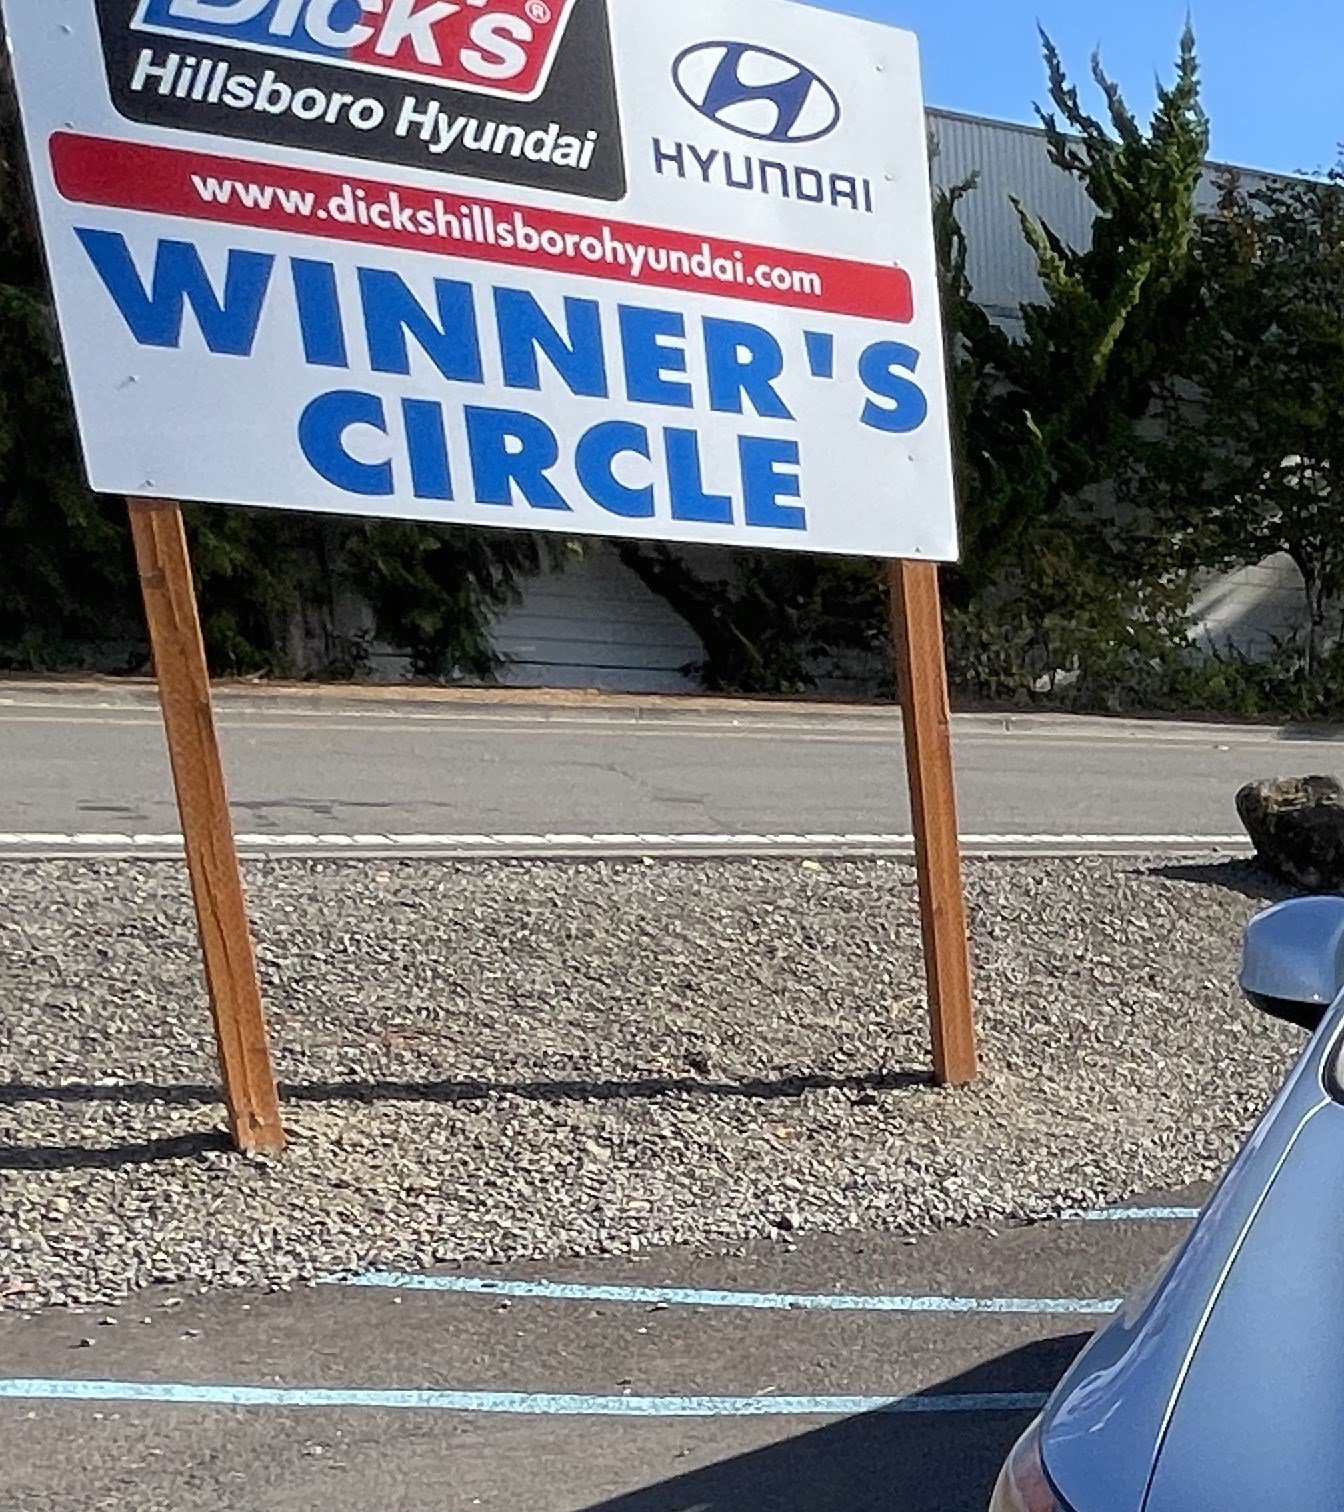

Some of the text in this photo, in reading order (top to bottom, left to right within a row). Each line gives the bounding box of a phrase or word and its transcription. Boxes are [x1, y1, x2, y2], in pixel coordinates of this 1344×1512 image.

[130, 48, 599, 170] Hillsboro Hyundai
[190, 173, 823, 297] www.dickshillsborohyundai.com
[652, 137, 873, 213] HYUNDAI
[73, 226, 929, 433] WINNER'S
[297, 388, 807, 531] CIRCLE
